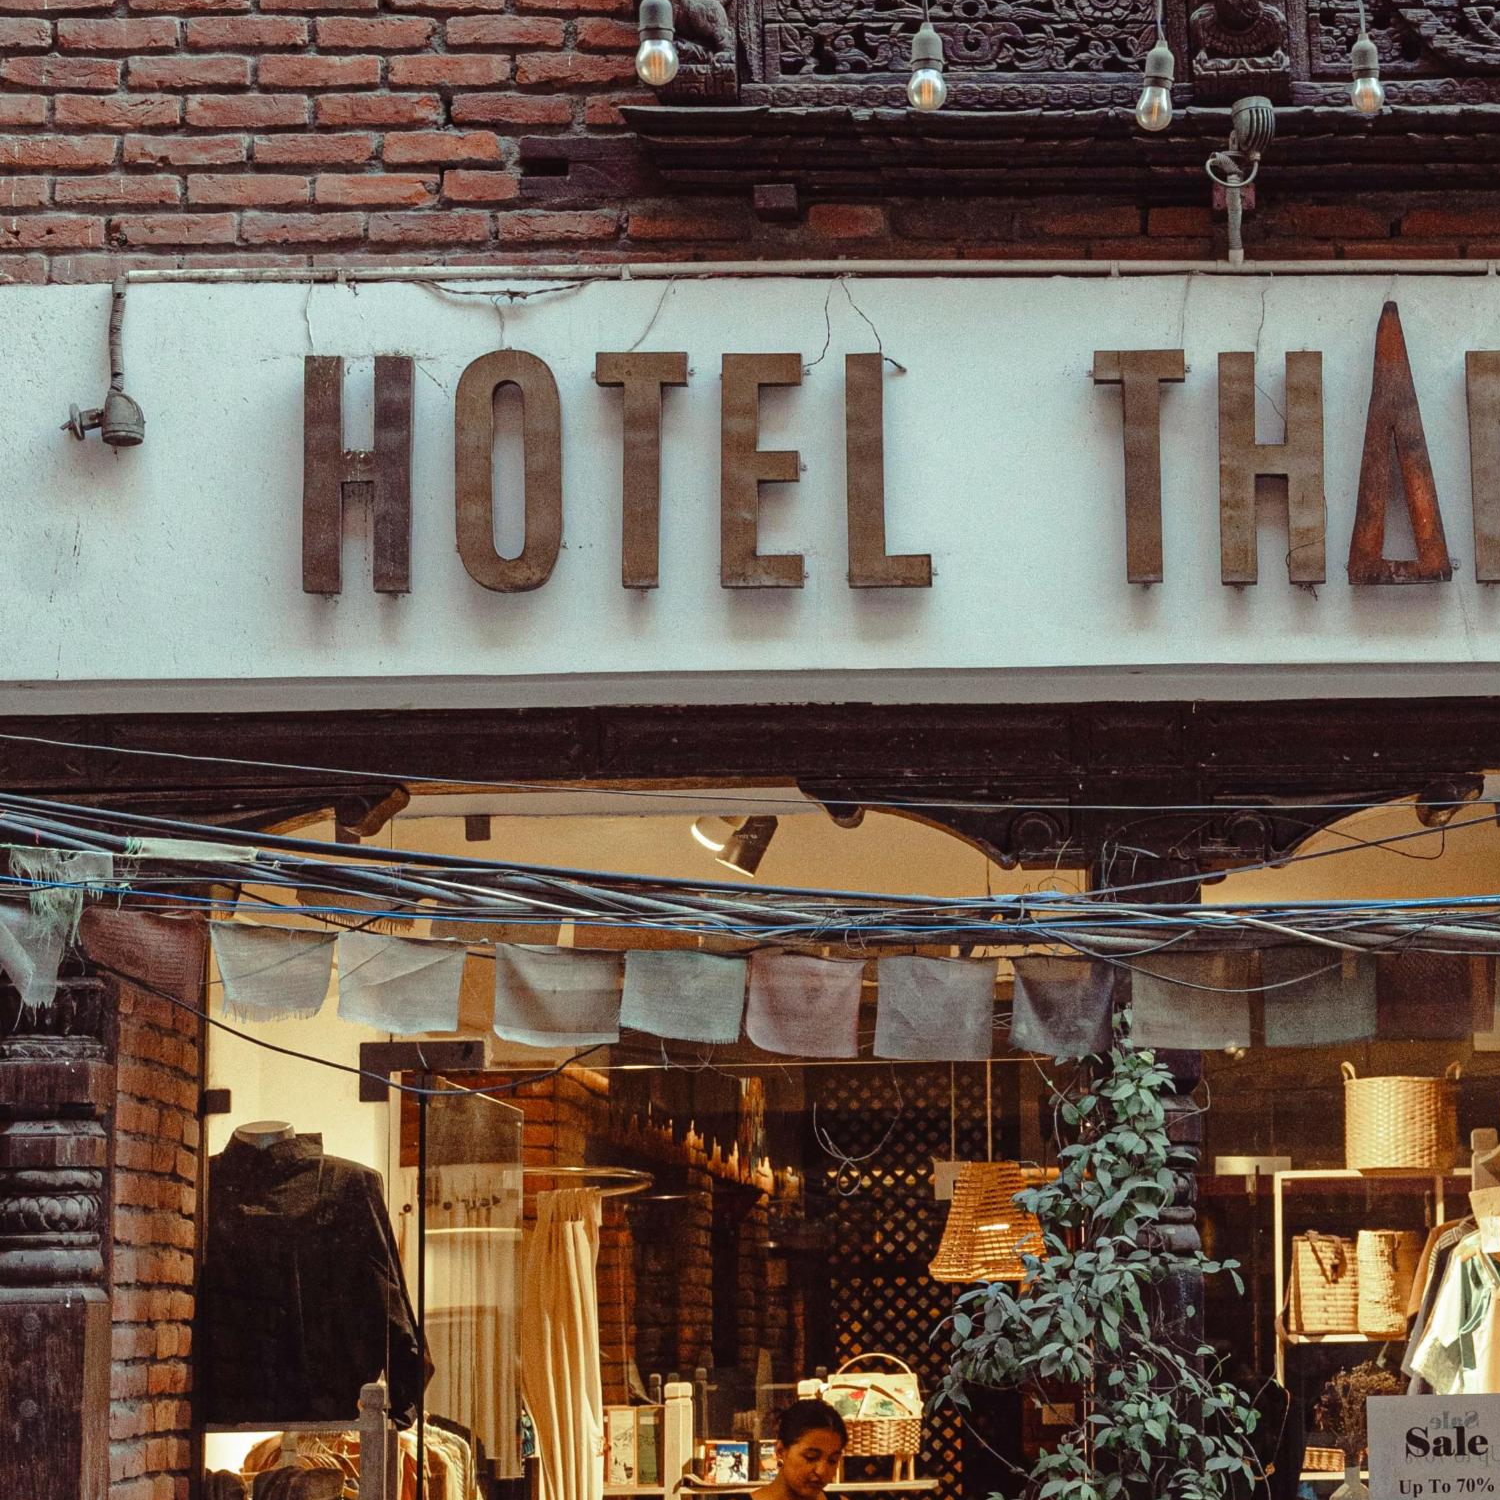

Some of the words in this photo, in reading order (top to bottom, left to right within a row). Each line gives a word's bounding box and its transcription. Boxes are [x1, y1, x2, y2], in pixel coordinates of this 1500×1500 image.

[302, 348, 933, 594] HOTEL
[1405, 1425, 1489, 1458] Sale
[1399, 1479, 1423, 1498] Up
[1428, 1478, 1451, 1494] To
[1457, 1477, 1495, 1494] 70%
